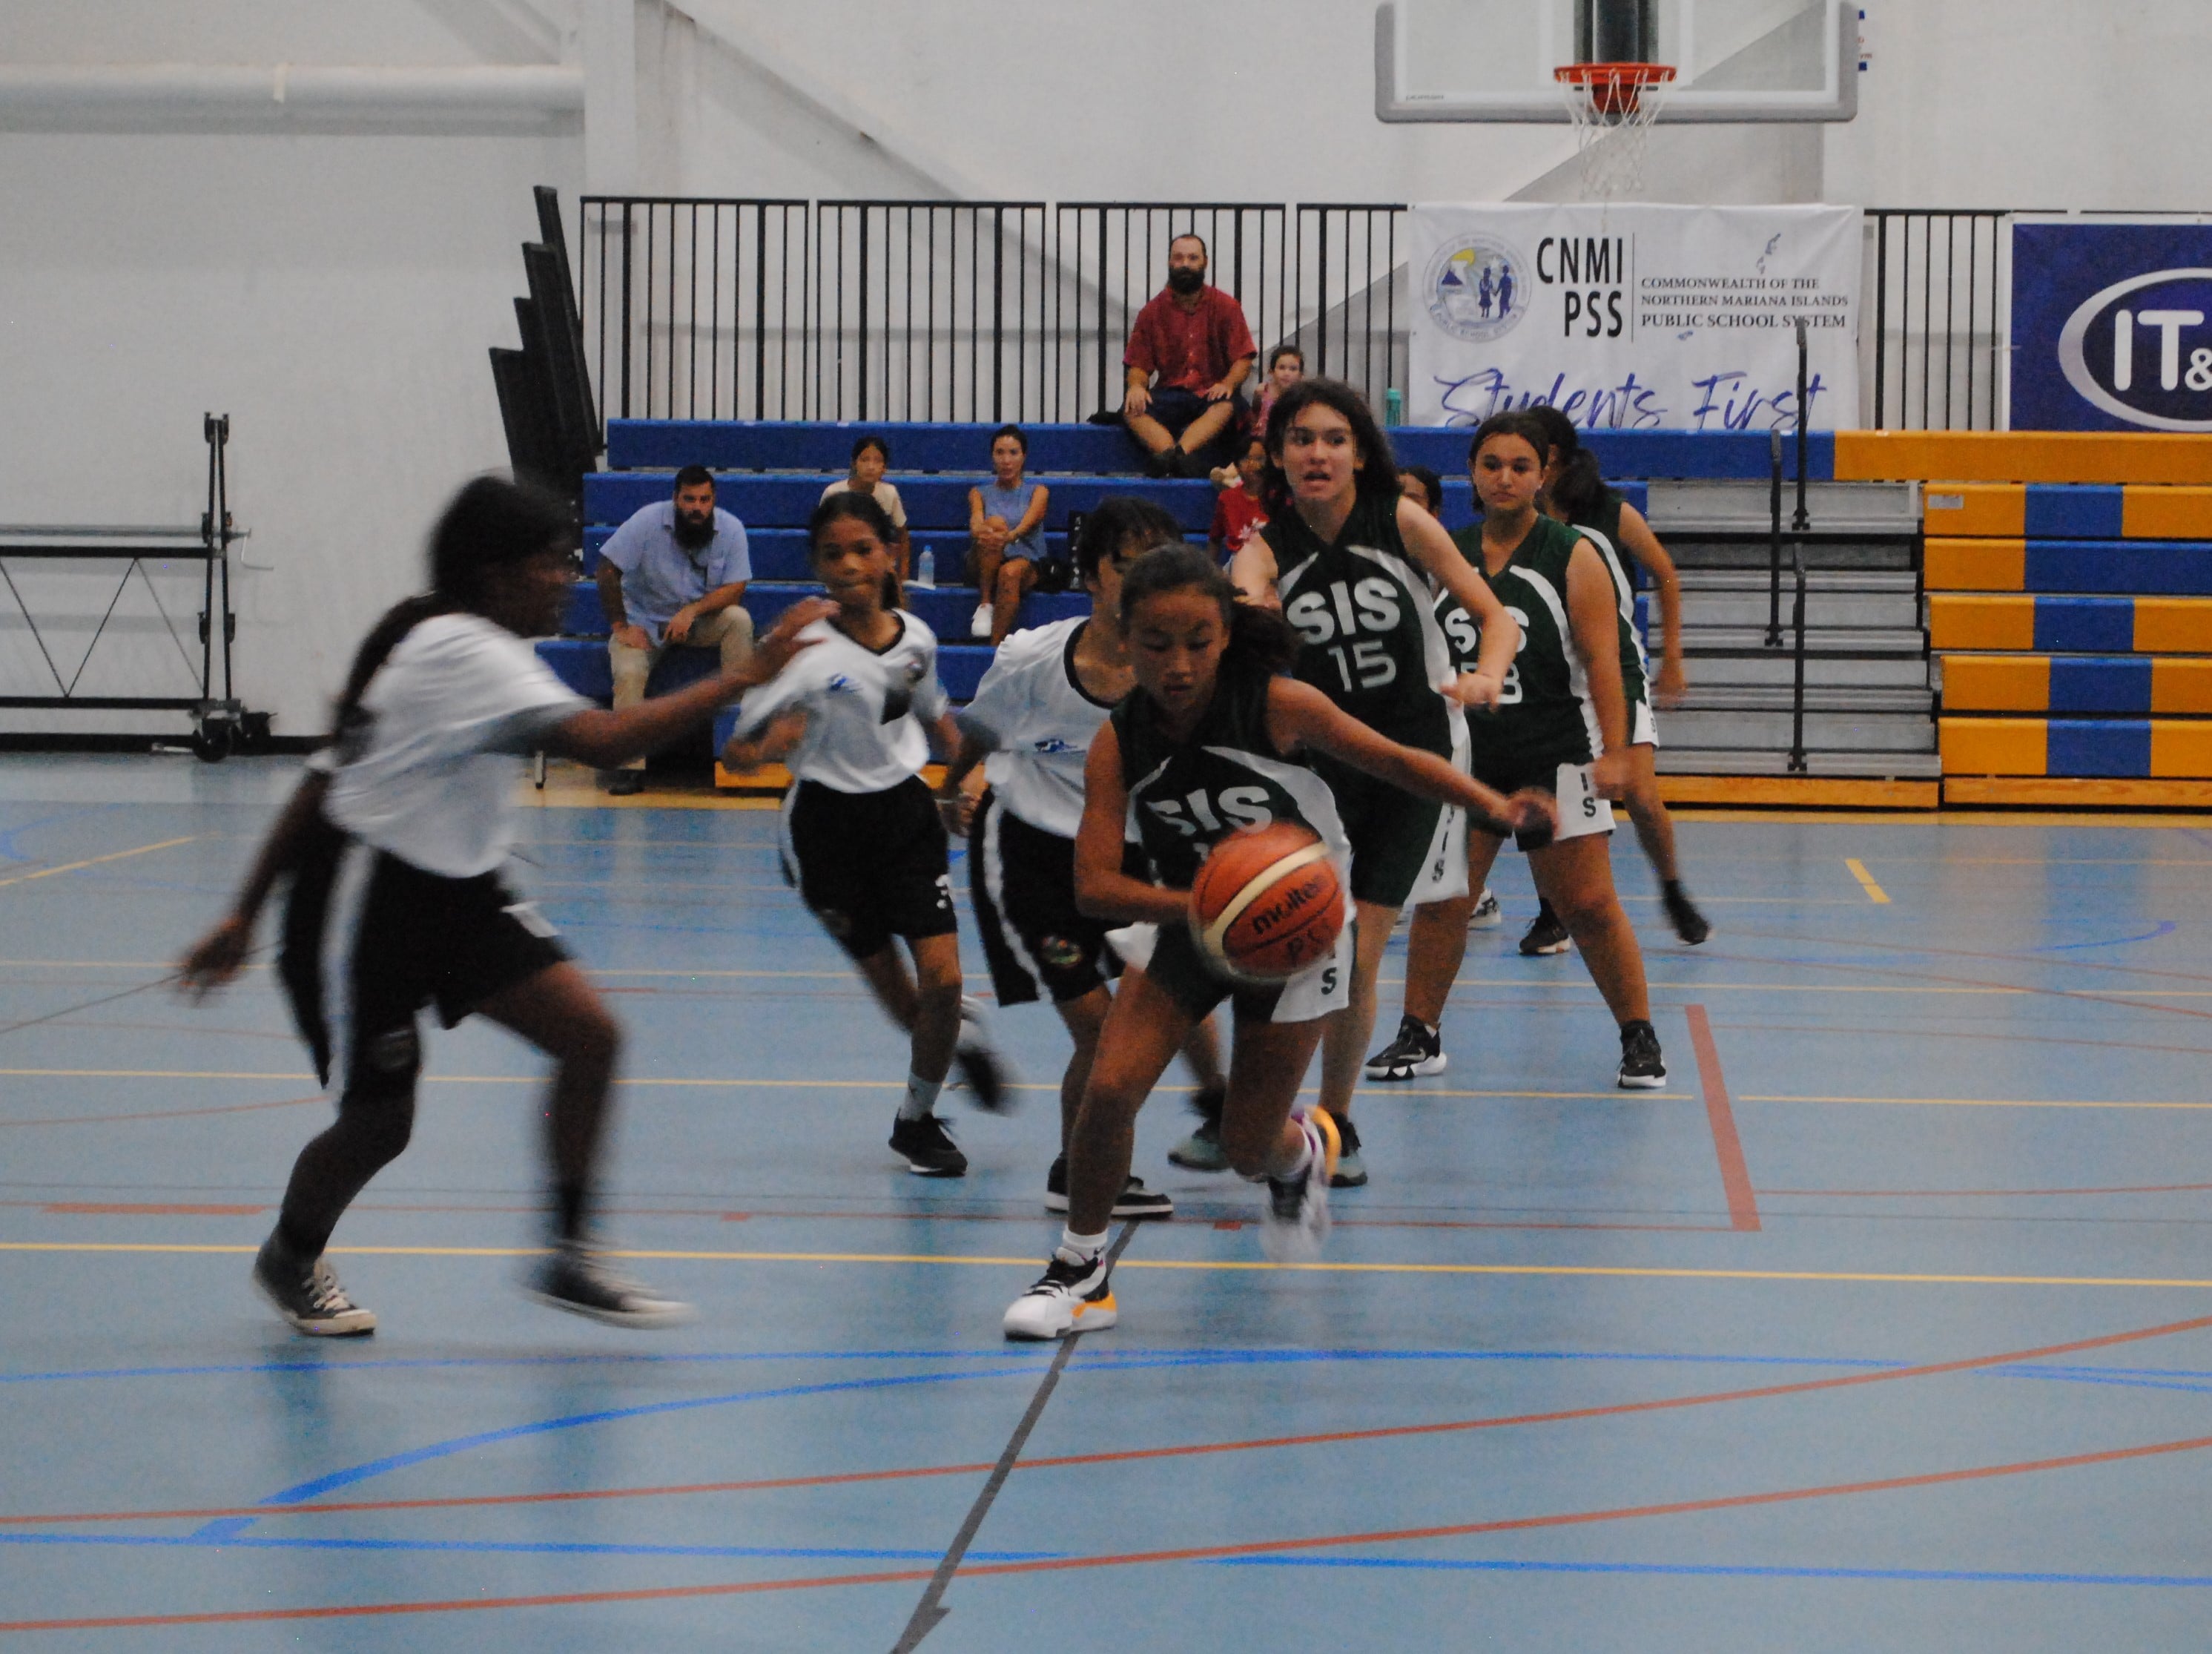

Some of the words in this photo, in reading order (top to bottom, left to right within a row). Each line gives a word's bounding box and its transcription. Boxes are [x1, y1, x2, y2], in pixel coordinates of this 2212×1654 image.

[1536, 237, 1622, 283] CNMI
[1641, 277, 1765, 289] COMMONWEALTH
[1769, 278, 1787, 289] OF
[1792, 278, 1820, 289] THE
[1564, 290, 1622, 337] PSS
[1641, 294, 1719, 306] NORTHERN
[1721, 294, 1787, 306] MARIANA
[1791, 296, 1849, 307] ISLANDS
[1641, 313, 1704, 327] PUBLIC
[1707, 314, 1778, 327] SCHOOL
[1782, 314, 1846, 327] SYSTEM
[1691, 371, 1827, 430] First
[1287, 576, 1401, 645] SIS
[1445, 606, 1530, 654] SS
[1327, 639, 1396, 693] 15
[1144, 785, 1272, 836] SIS
